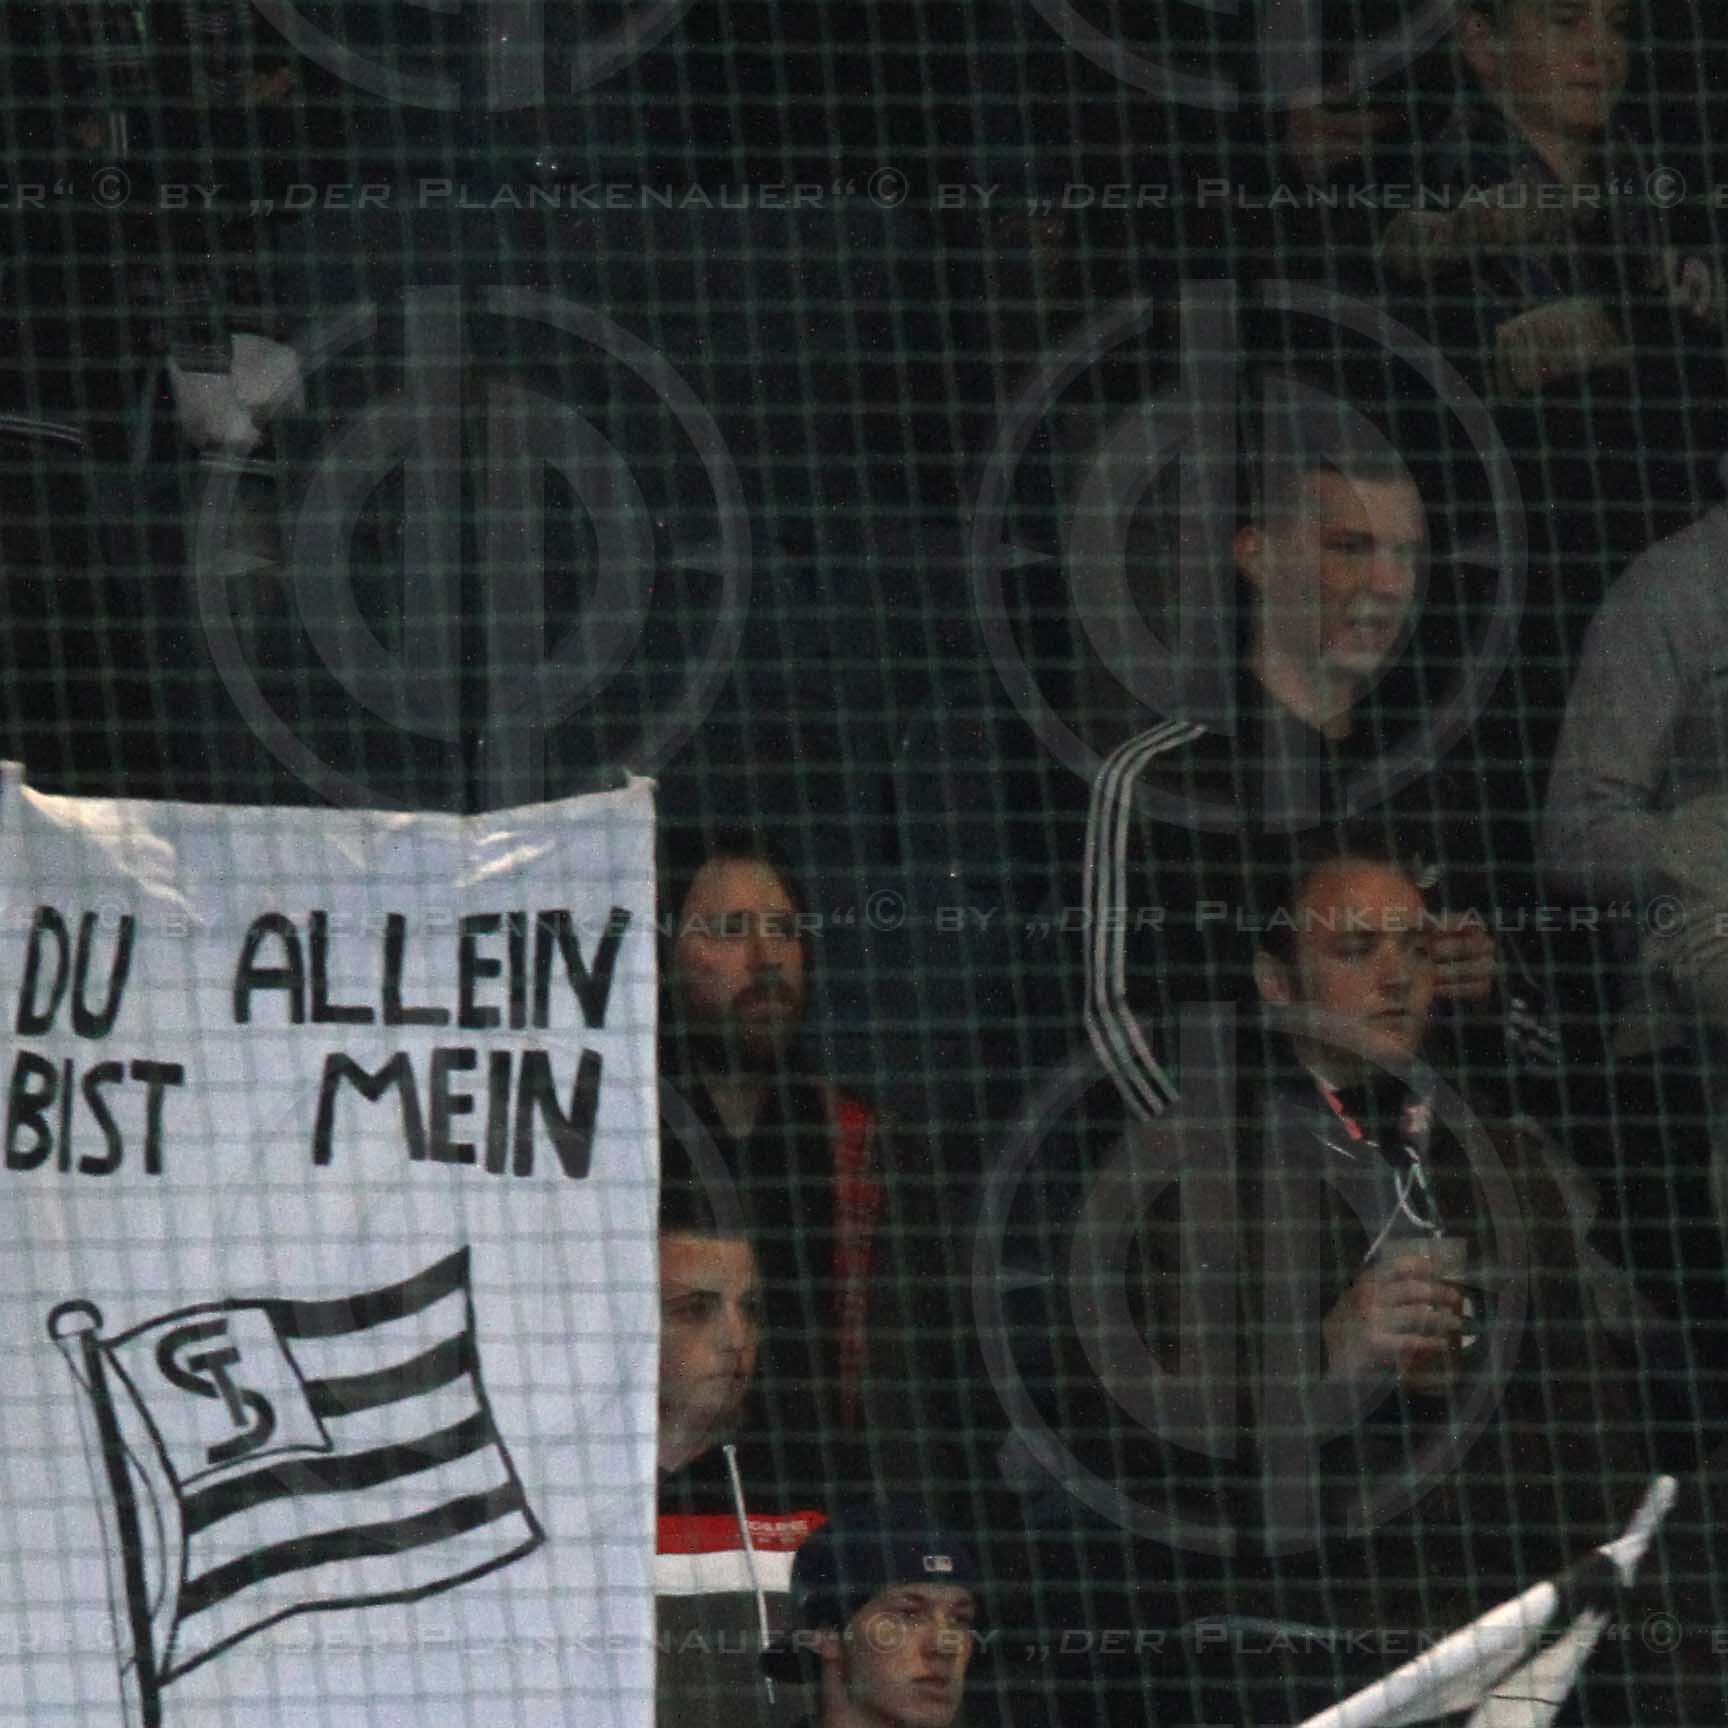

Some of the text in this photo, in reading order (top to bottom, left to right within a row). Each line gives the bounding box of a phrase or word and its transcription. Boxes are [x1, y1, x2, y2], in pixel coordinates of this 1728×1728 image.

[17, 904, 631, 1037] DU ALLEIN
[5, 1048, 601, 1178] BIST MEIN
